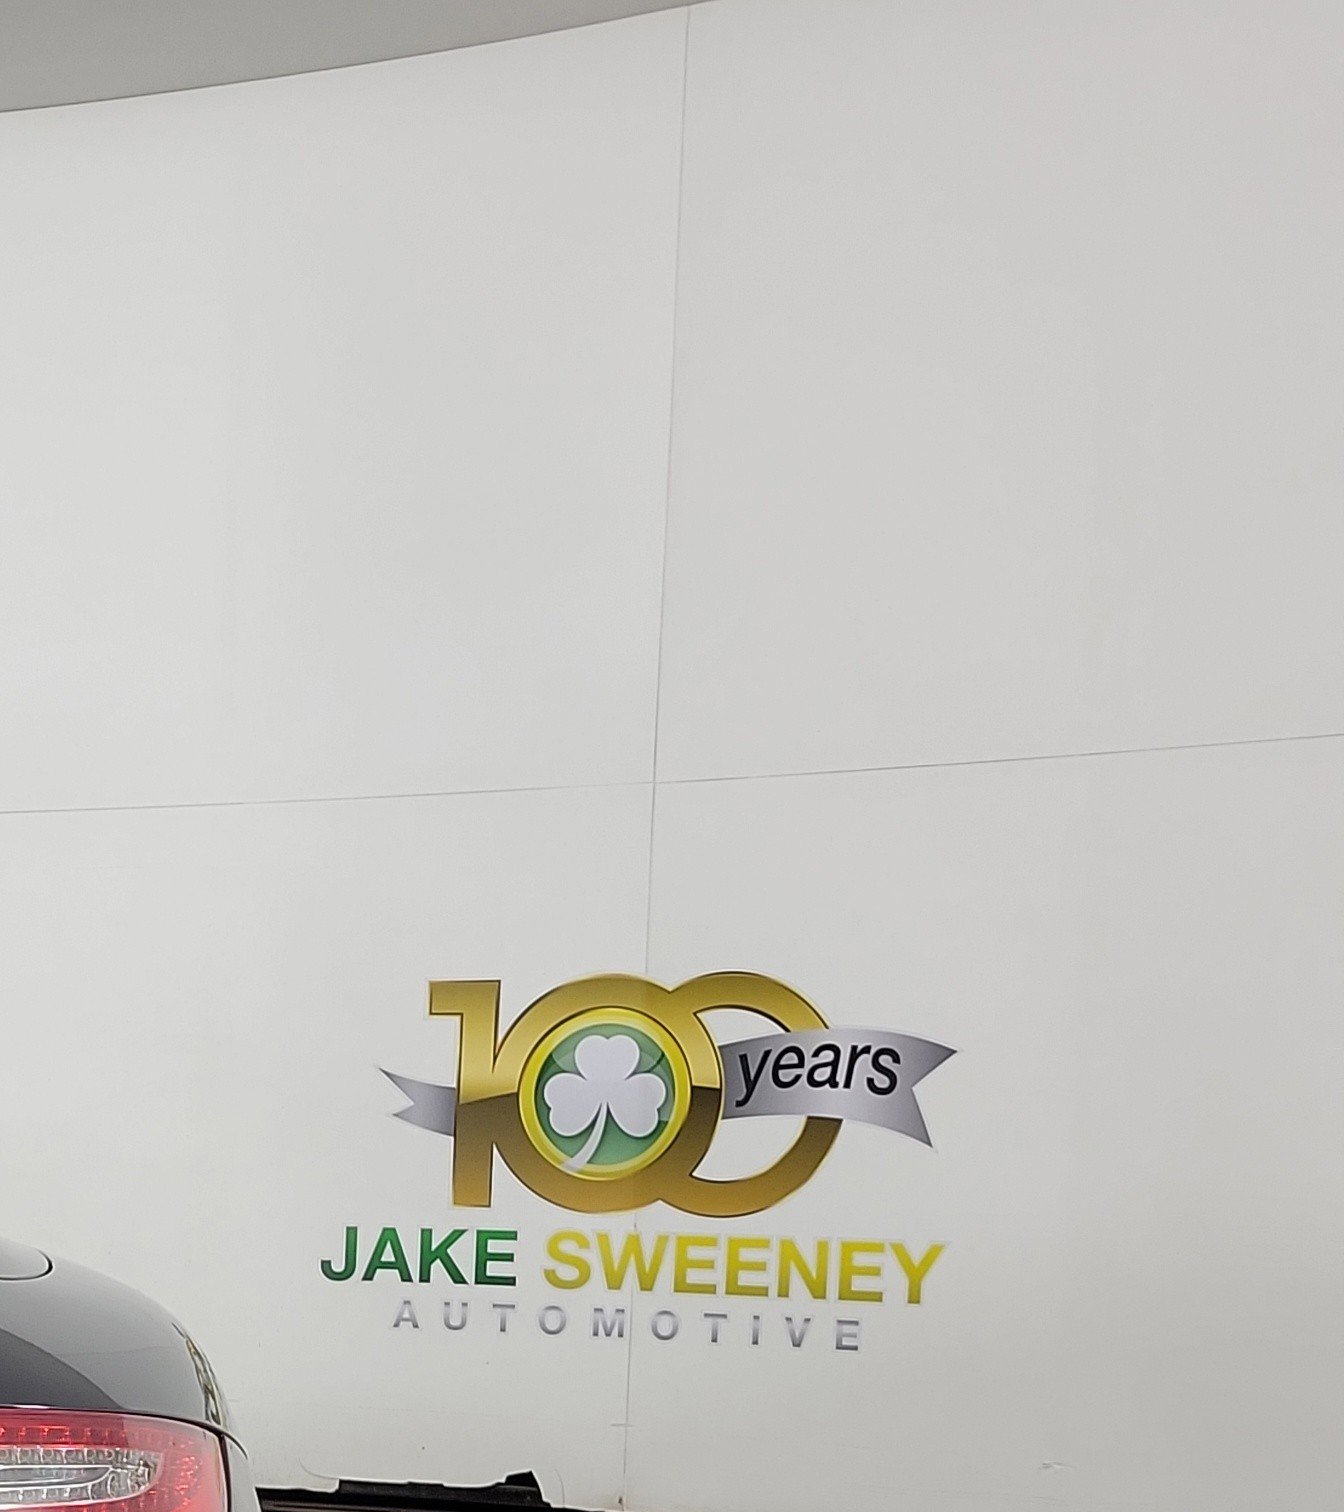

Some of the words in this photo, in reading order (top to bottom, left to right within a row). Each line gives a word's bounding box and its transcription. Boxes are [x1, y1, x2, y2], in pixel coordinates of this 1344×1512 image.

[429, 971, 843, 1218] 100
[734, 1042, 902, 1108] years
[320, 1226, 518, 1287] JAKE
[543, 1229, 945, 1305] SWEENEY
[393, 1300, 860, 1351] AUTOMOTIVE
